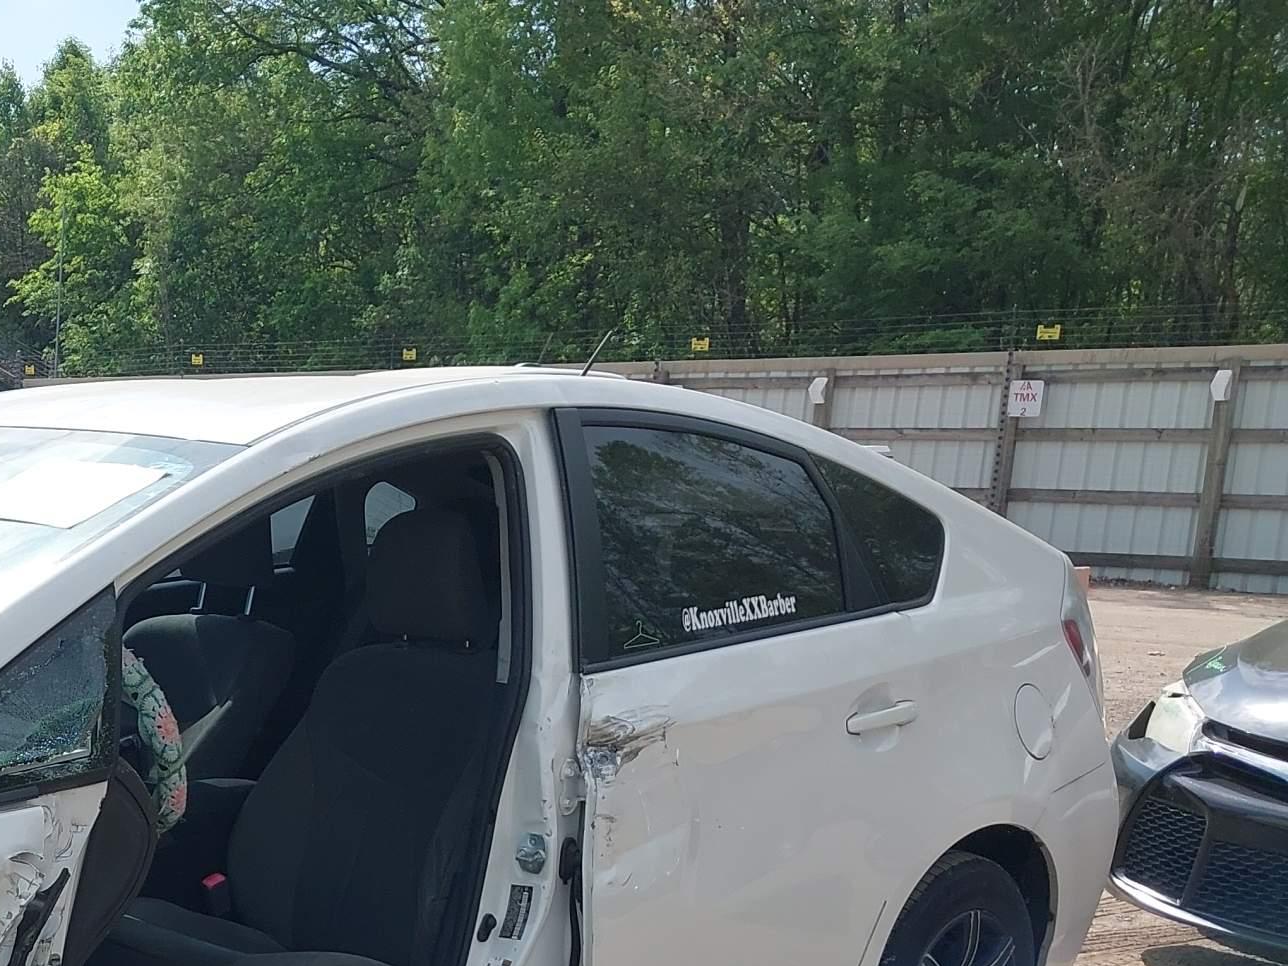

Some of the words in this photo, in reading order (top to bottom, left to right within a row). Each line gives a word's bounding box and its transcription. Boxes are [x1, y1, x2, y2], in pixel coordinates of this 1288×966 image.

[1014, 392, 1037, 402] TMX
[1020, 407, 1027, 416] 2
[682, 593, 797, 632] @KnoxvilleXXBarber
